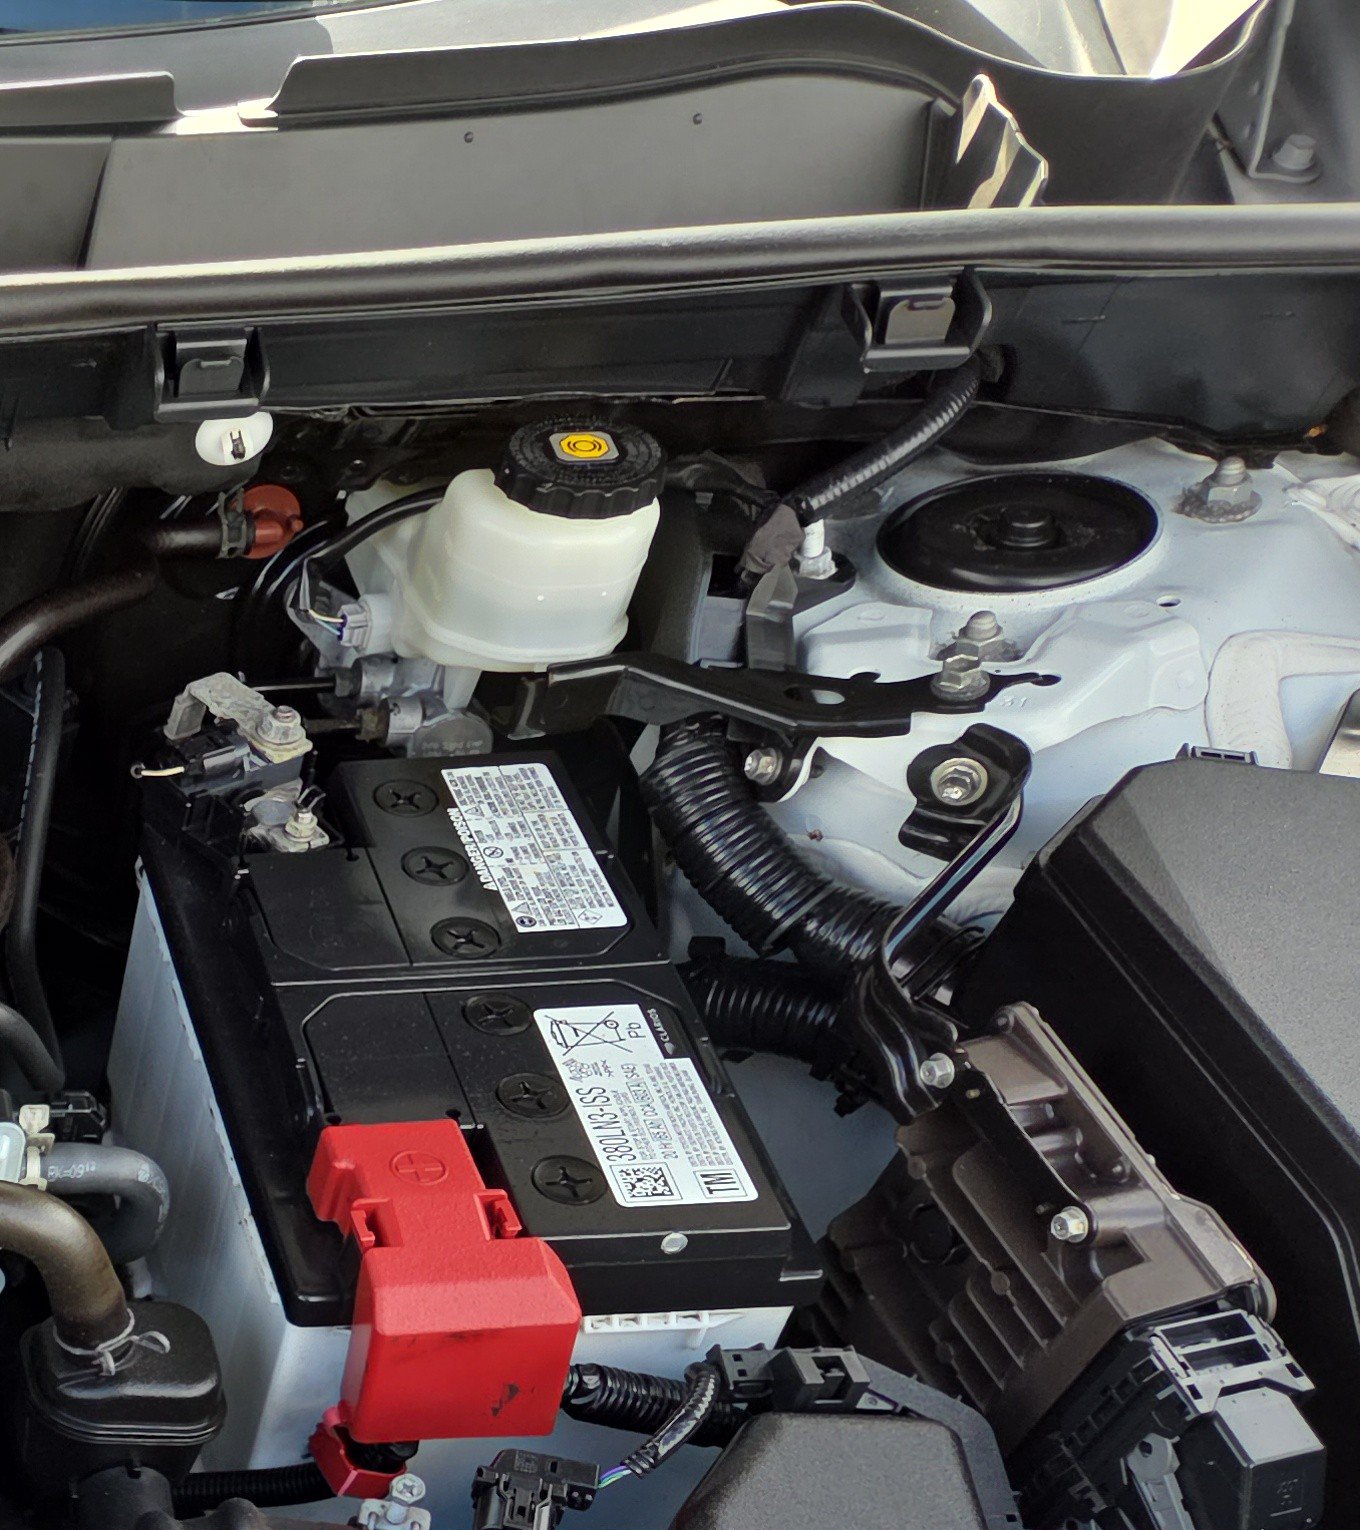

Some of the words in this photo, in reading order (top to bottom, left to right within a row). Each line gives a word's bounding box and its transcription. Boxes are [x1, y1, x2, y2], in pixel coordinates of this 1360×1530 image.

[626, 1022, 647, 1039] Pb
[576, 1087, 637, 1161] 380LN3-ISS
[699, 1172, 740, 1195] TM
